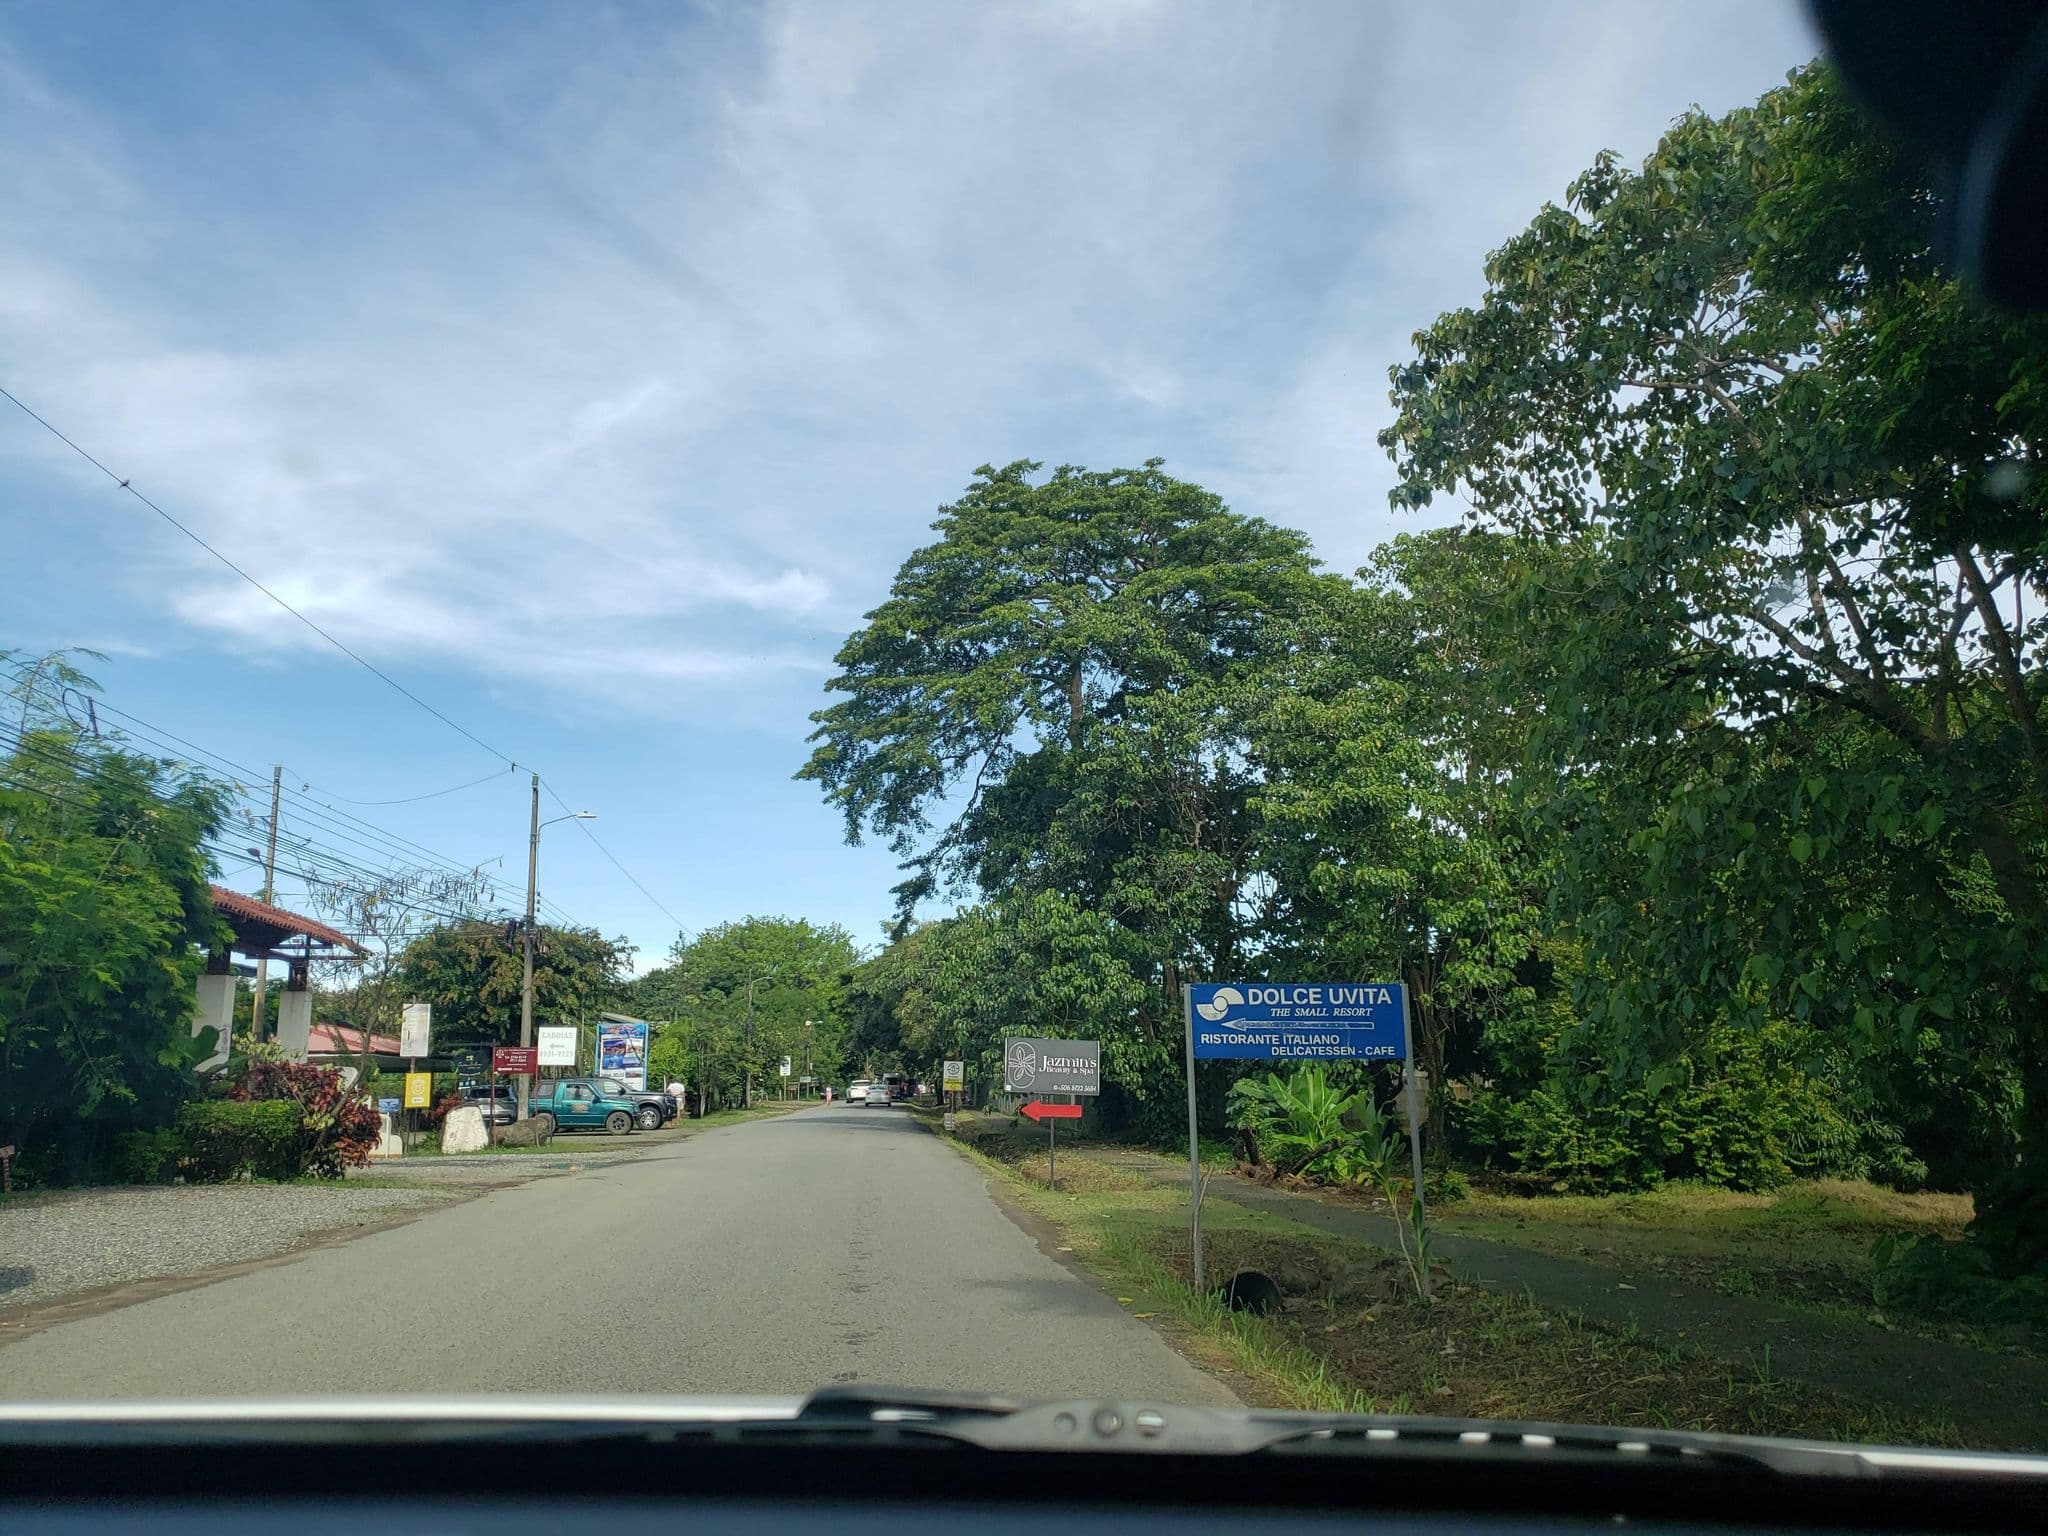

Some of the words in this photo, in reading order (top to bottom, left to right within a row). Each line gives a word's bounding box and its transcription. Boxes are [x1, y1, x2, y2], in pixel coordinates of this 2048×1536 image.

[1248, 987, 1322, 1005] DOLCE
[1328, 987, 1392, 1005] UVITA
[1270, 1008, 1291, 1017] THE
[1294, 1008, 1329, 1017] SMALL
[1333, 1008, 1374, 1017] RESORT
[1201, 1033, 1280, 1045] RISTORANTE
[1283, 1034, 1340, 1045] ITALIANO
[1271, 1046, 1356, 1056] DELICATESSEN
[1365, 1046, 1396, 1056] CAFE
[1039, 1055, 1097, 1072] Jazmin's
[1046, 1066, 1071, 1075] Beauty
[1080, 1066, 1094, 1076] Spa
